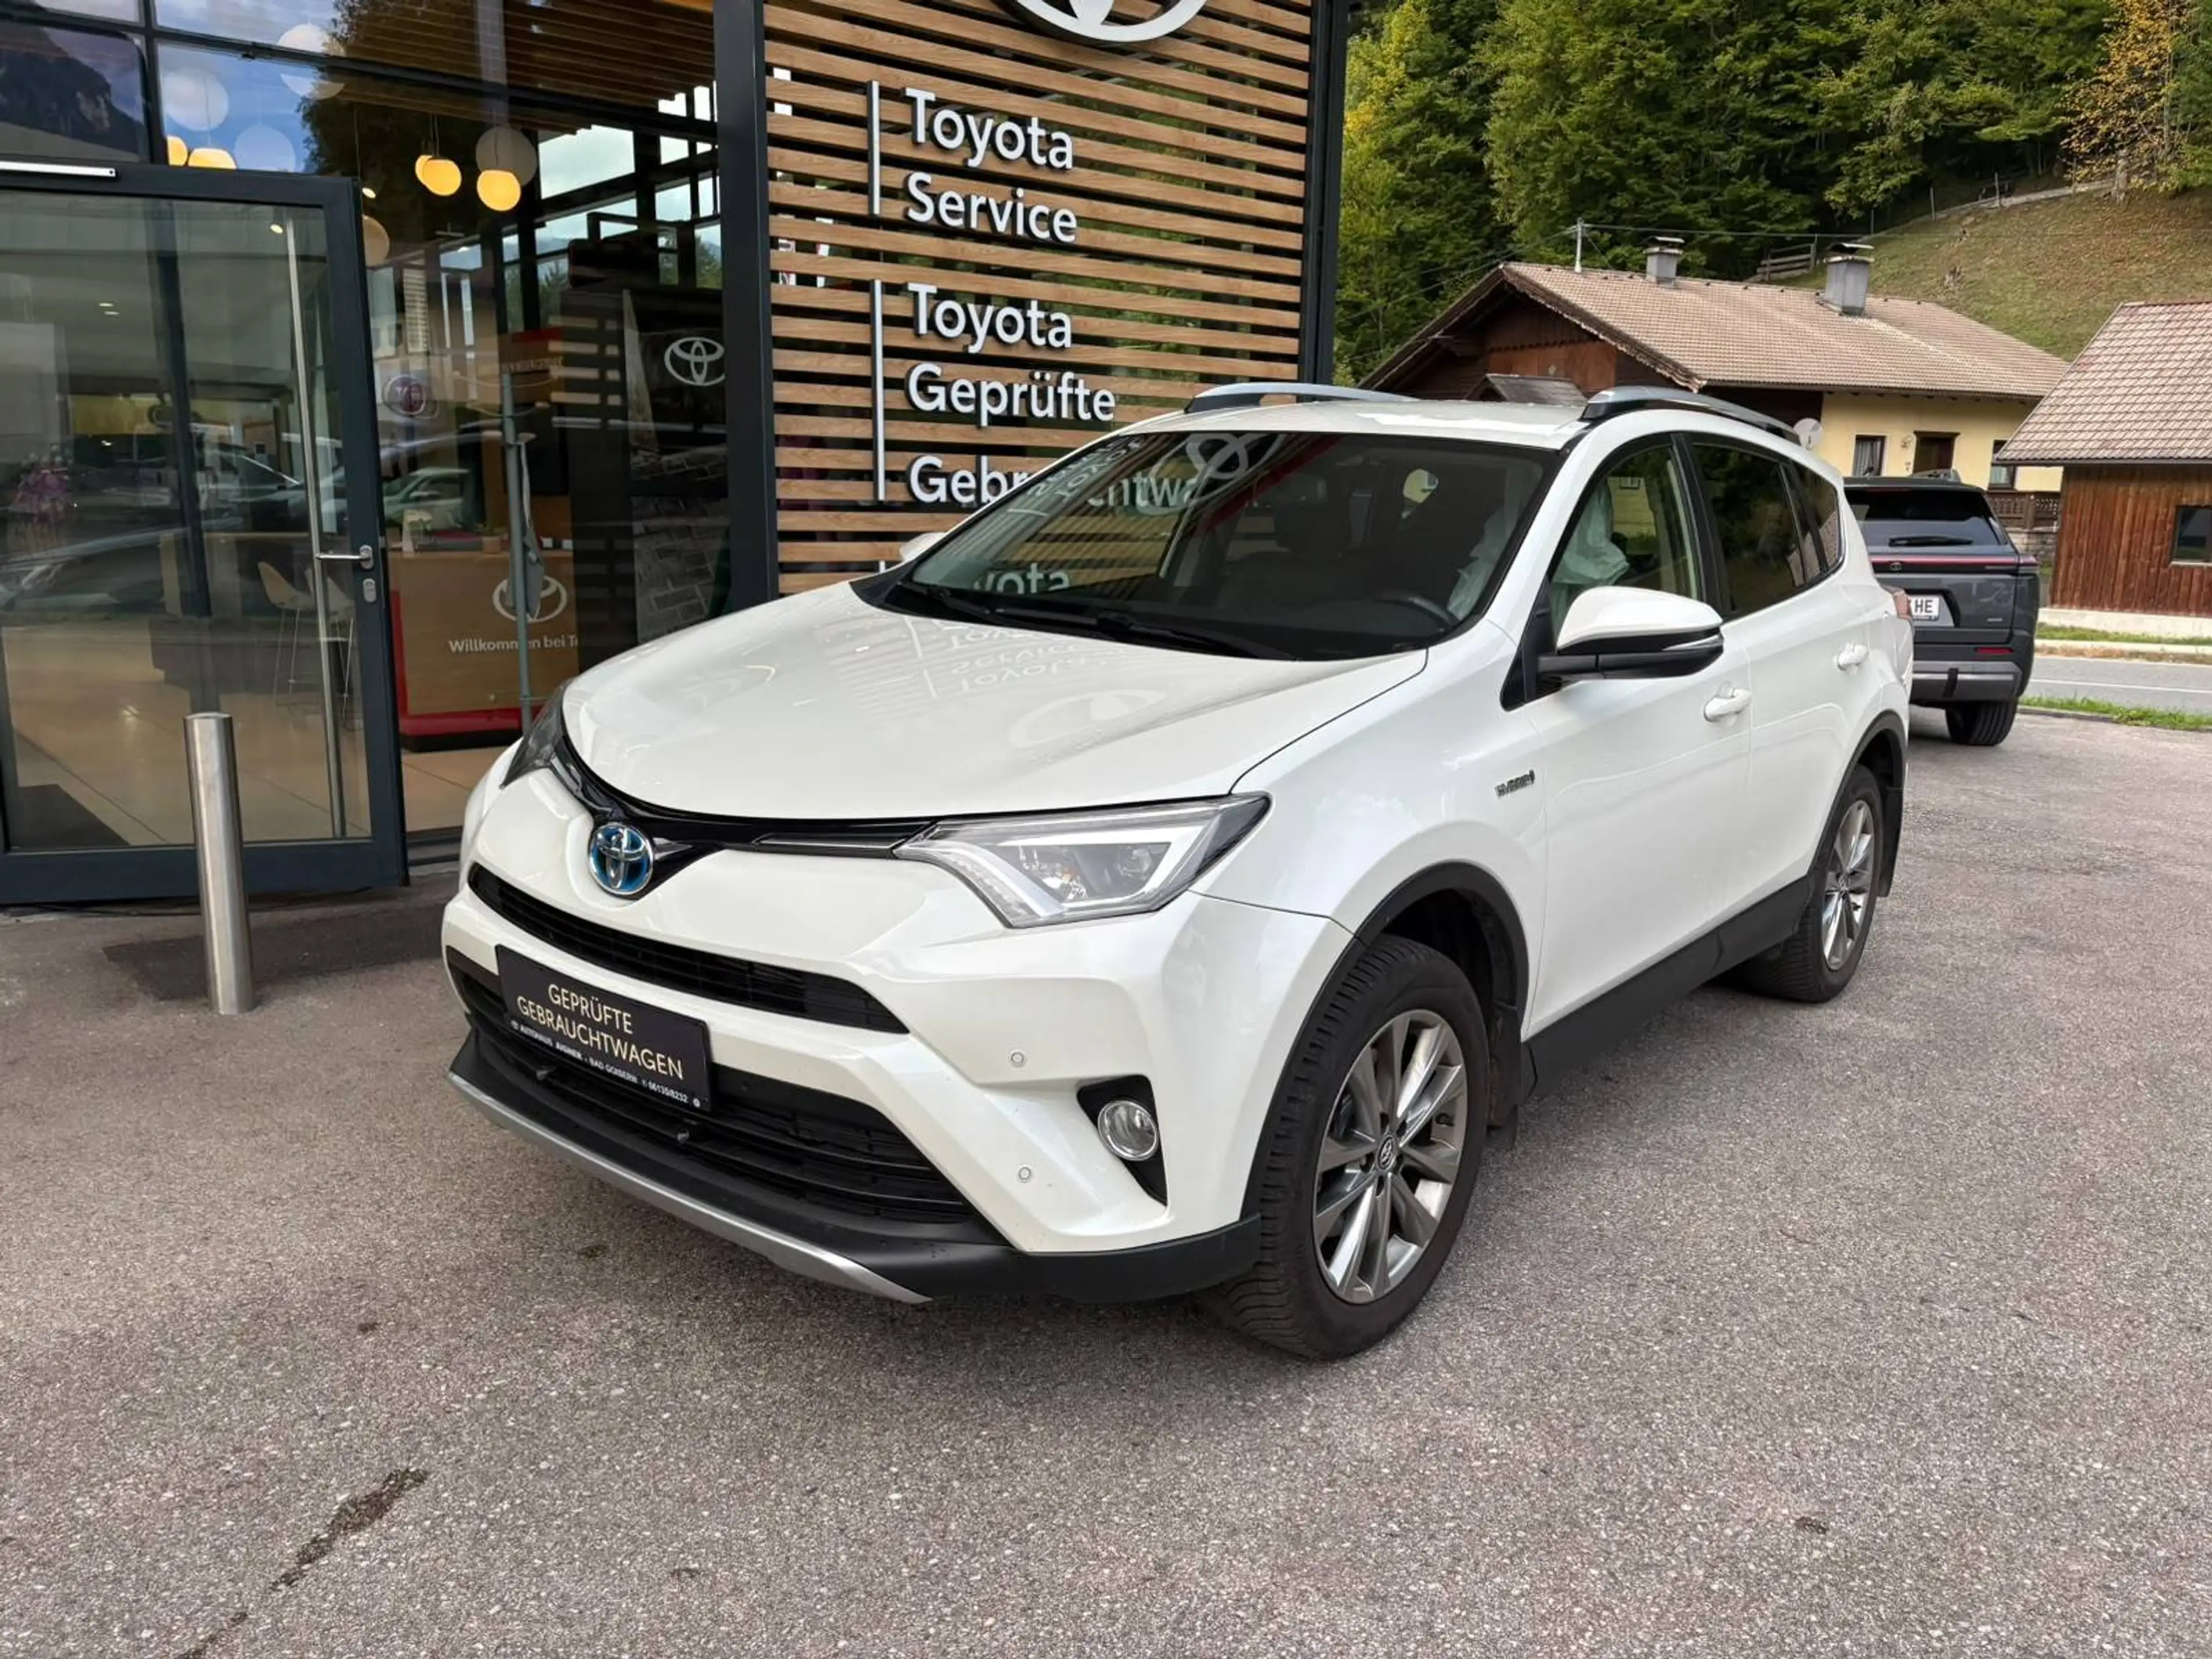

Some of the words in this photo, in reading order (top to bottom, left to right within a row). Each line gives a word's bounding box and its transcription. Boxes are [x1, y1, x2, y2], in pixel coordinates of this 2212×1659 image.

[905, 87, 1074, 170] Toyota
[906, 172, 1077, 244] Service
[907, 283, 1072, 353] Toyota
[907, 362, 1116, 427] Geprüfte
[448, 638, 541, 653] Willkommn
[543, 634, 566, 649] bei
[517, 995, 684, 1081] GEBRAUCHTWAGEN
[548, 983, 634, 1035] GEPRÜFTE
